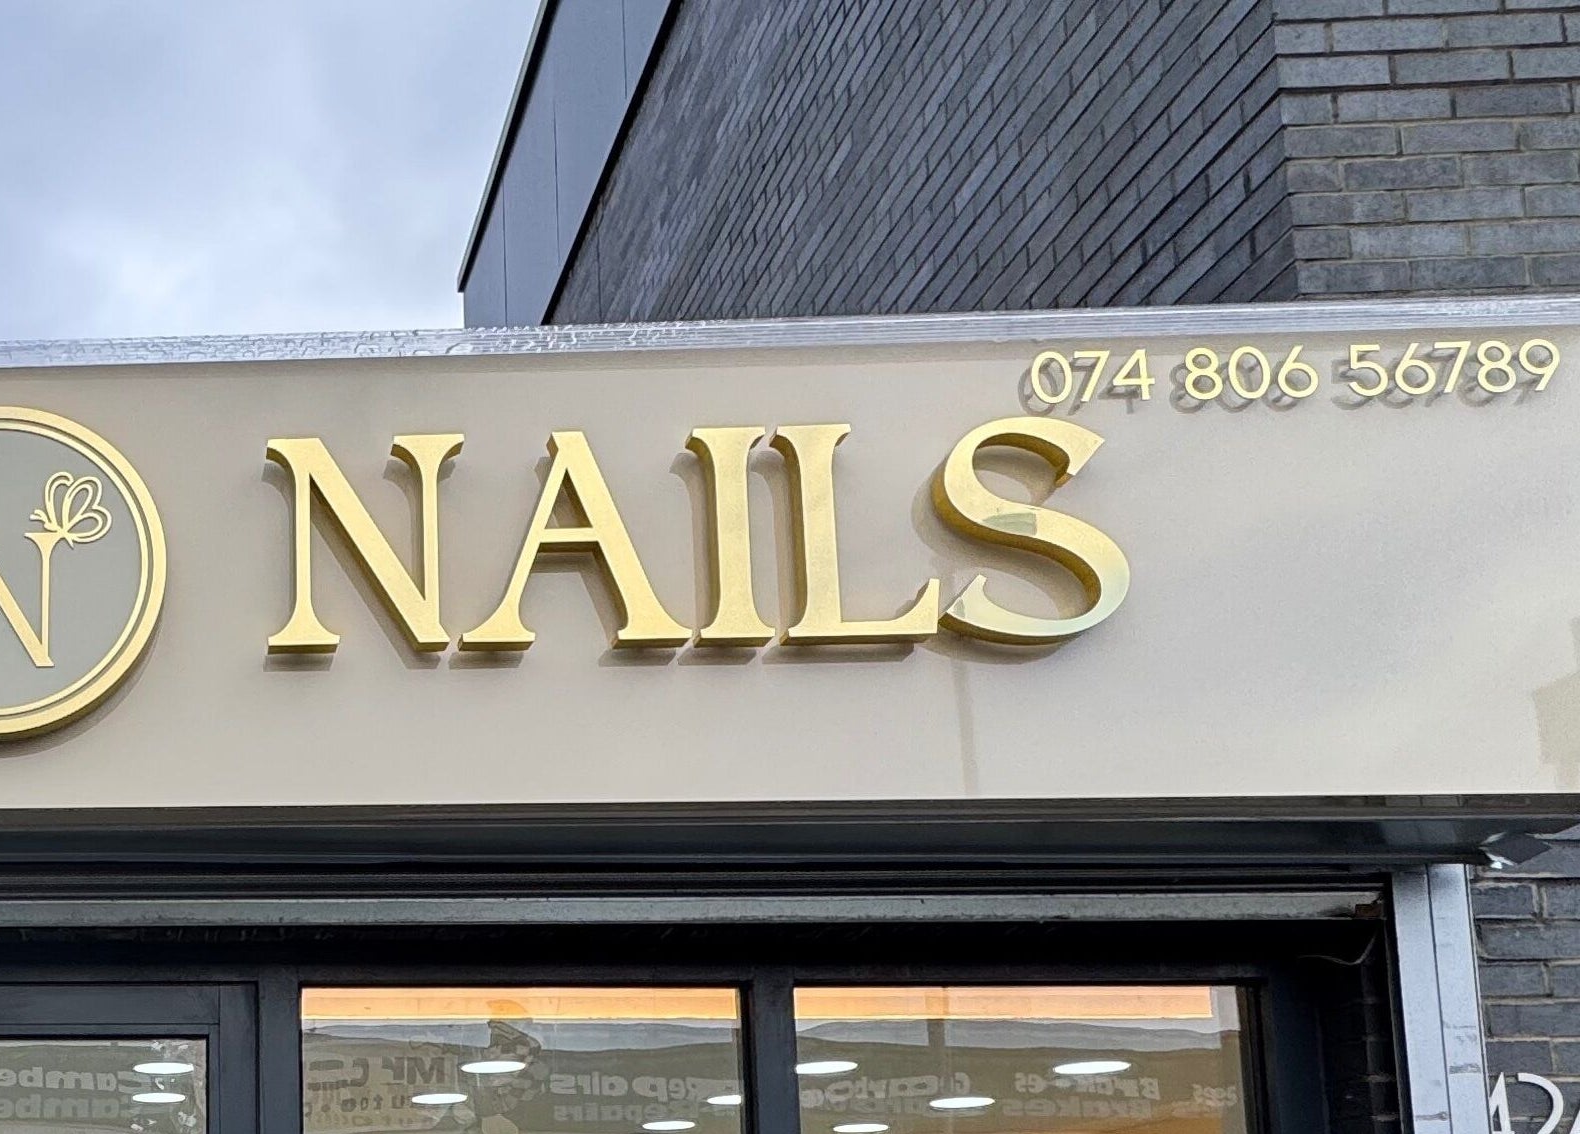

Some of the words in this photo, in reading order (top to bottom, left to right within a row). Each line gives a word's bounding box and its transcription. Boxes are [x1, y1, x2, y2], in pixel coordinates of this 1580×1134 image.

[1030, 348, 1156, 404] 074
[1184, 345, 1319, 400] 806
[1347, 338, 1561, 397] 56789
[266, 416, 1131, 654] NAILS
